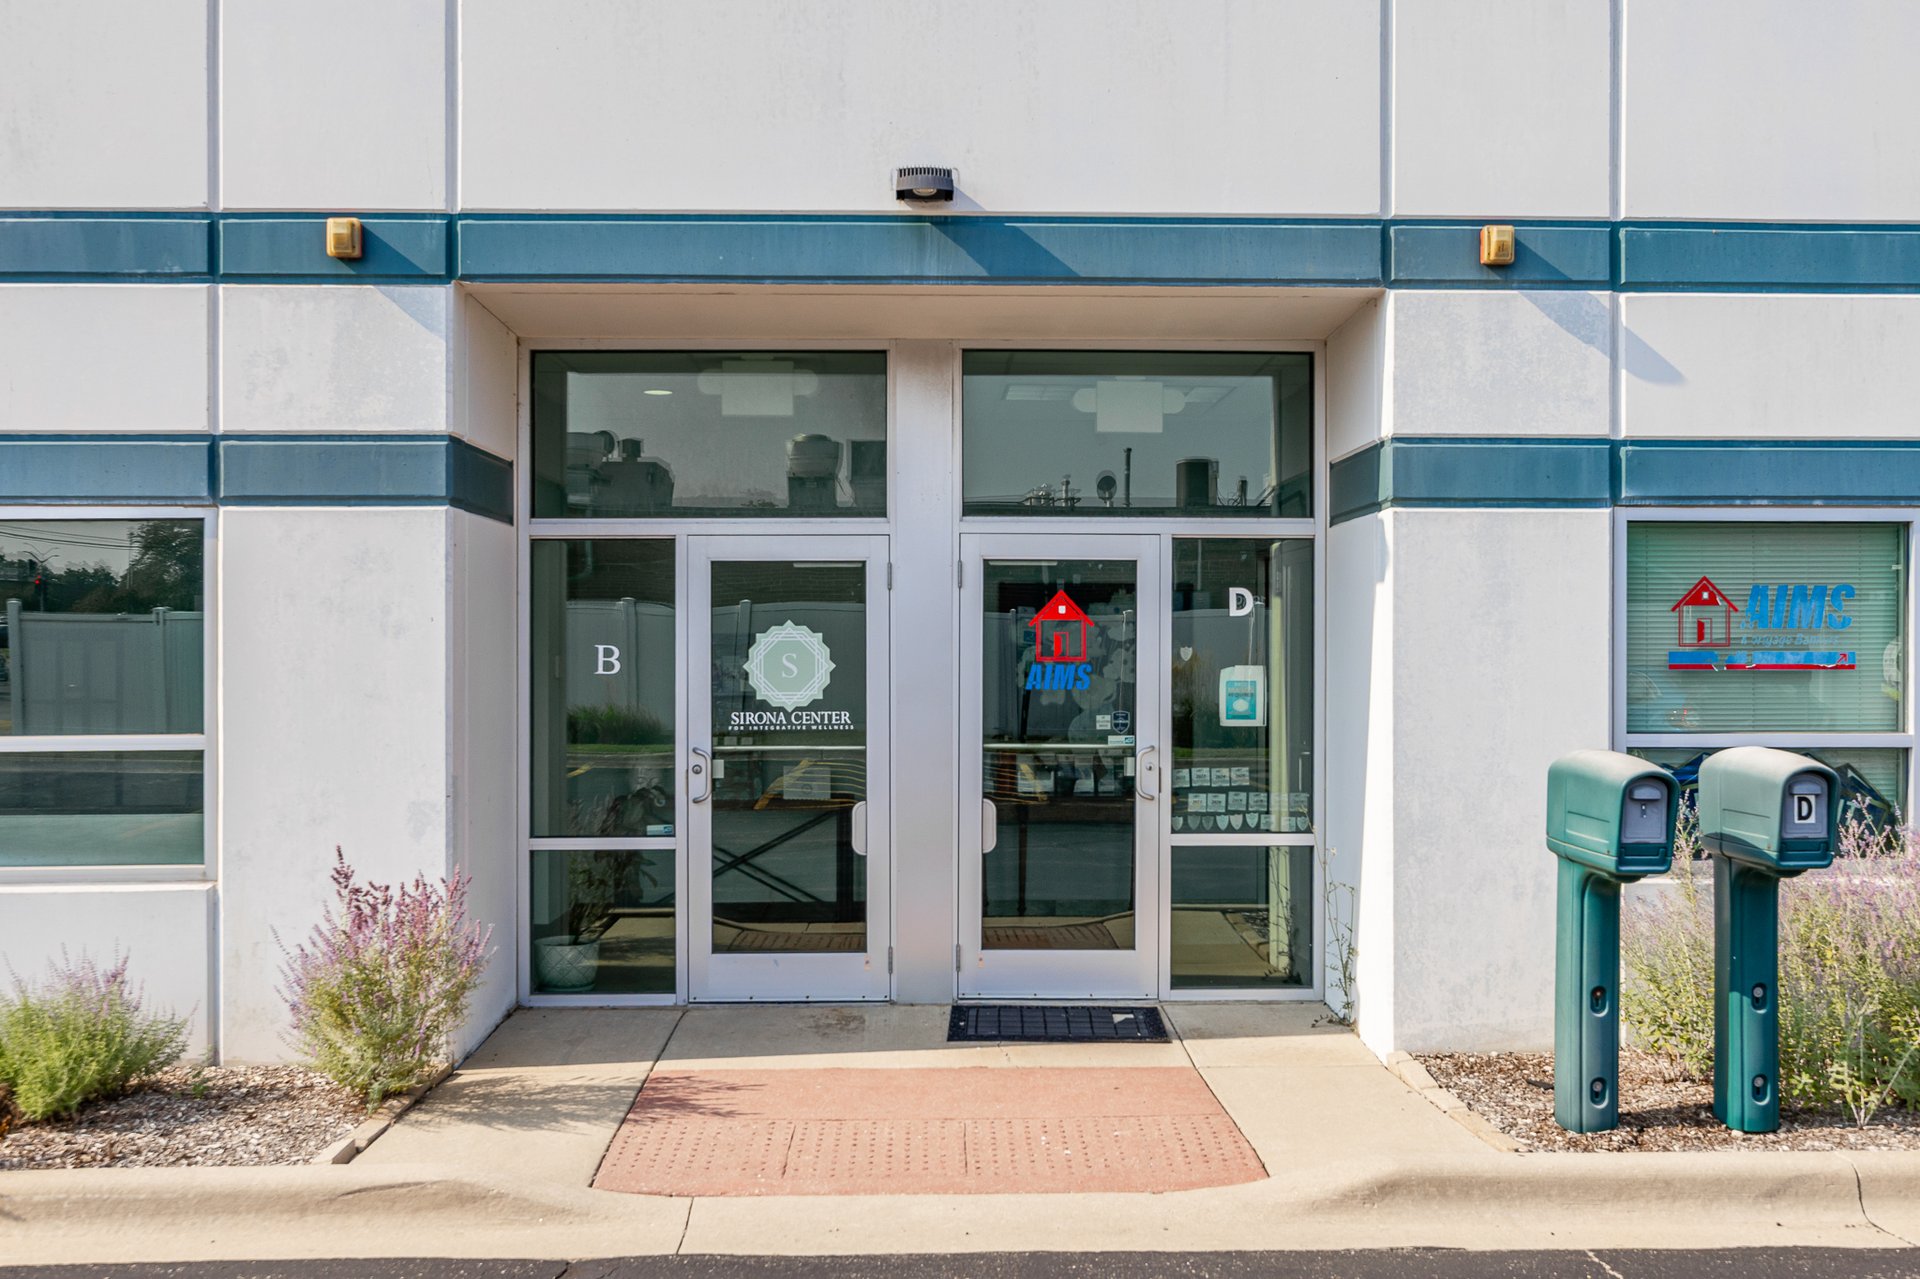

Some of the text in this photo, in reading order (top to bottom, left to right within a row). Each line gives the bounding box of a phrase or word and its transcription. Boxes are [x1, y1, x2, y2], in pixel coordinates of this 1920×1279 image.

[1229, 587, 1254, 617] D
[1740, 583, 1856, 630] AIMS
[594, 644, 622, 676] B
[781, 652, 799, 679] S
[1025, 663, 1093, 691] AIMS
[730, 711, 851, 725] SIRONA CENTER
[1797, 796, 1813, 821] D
